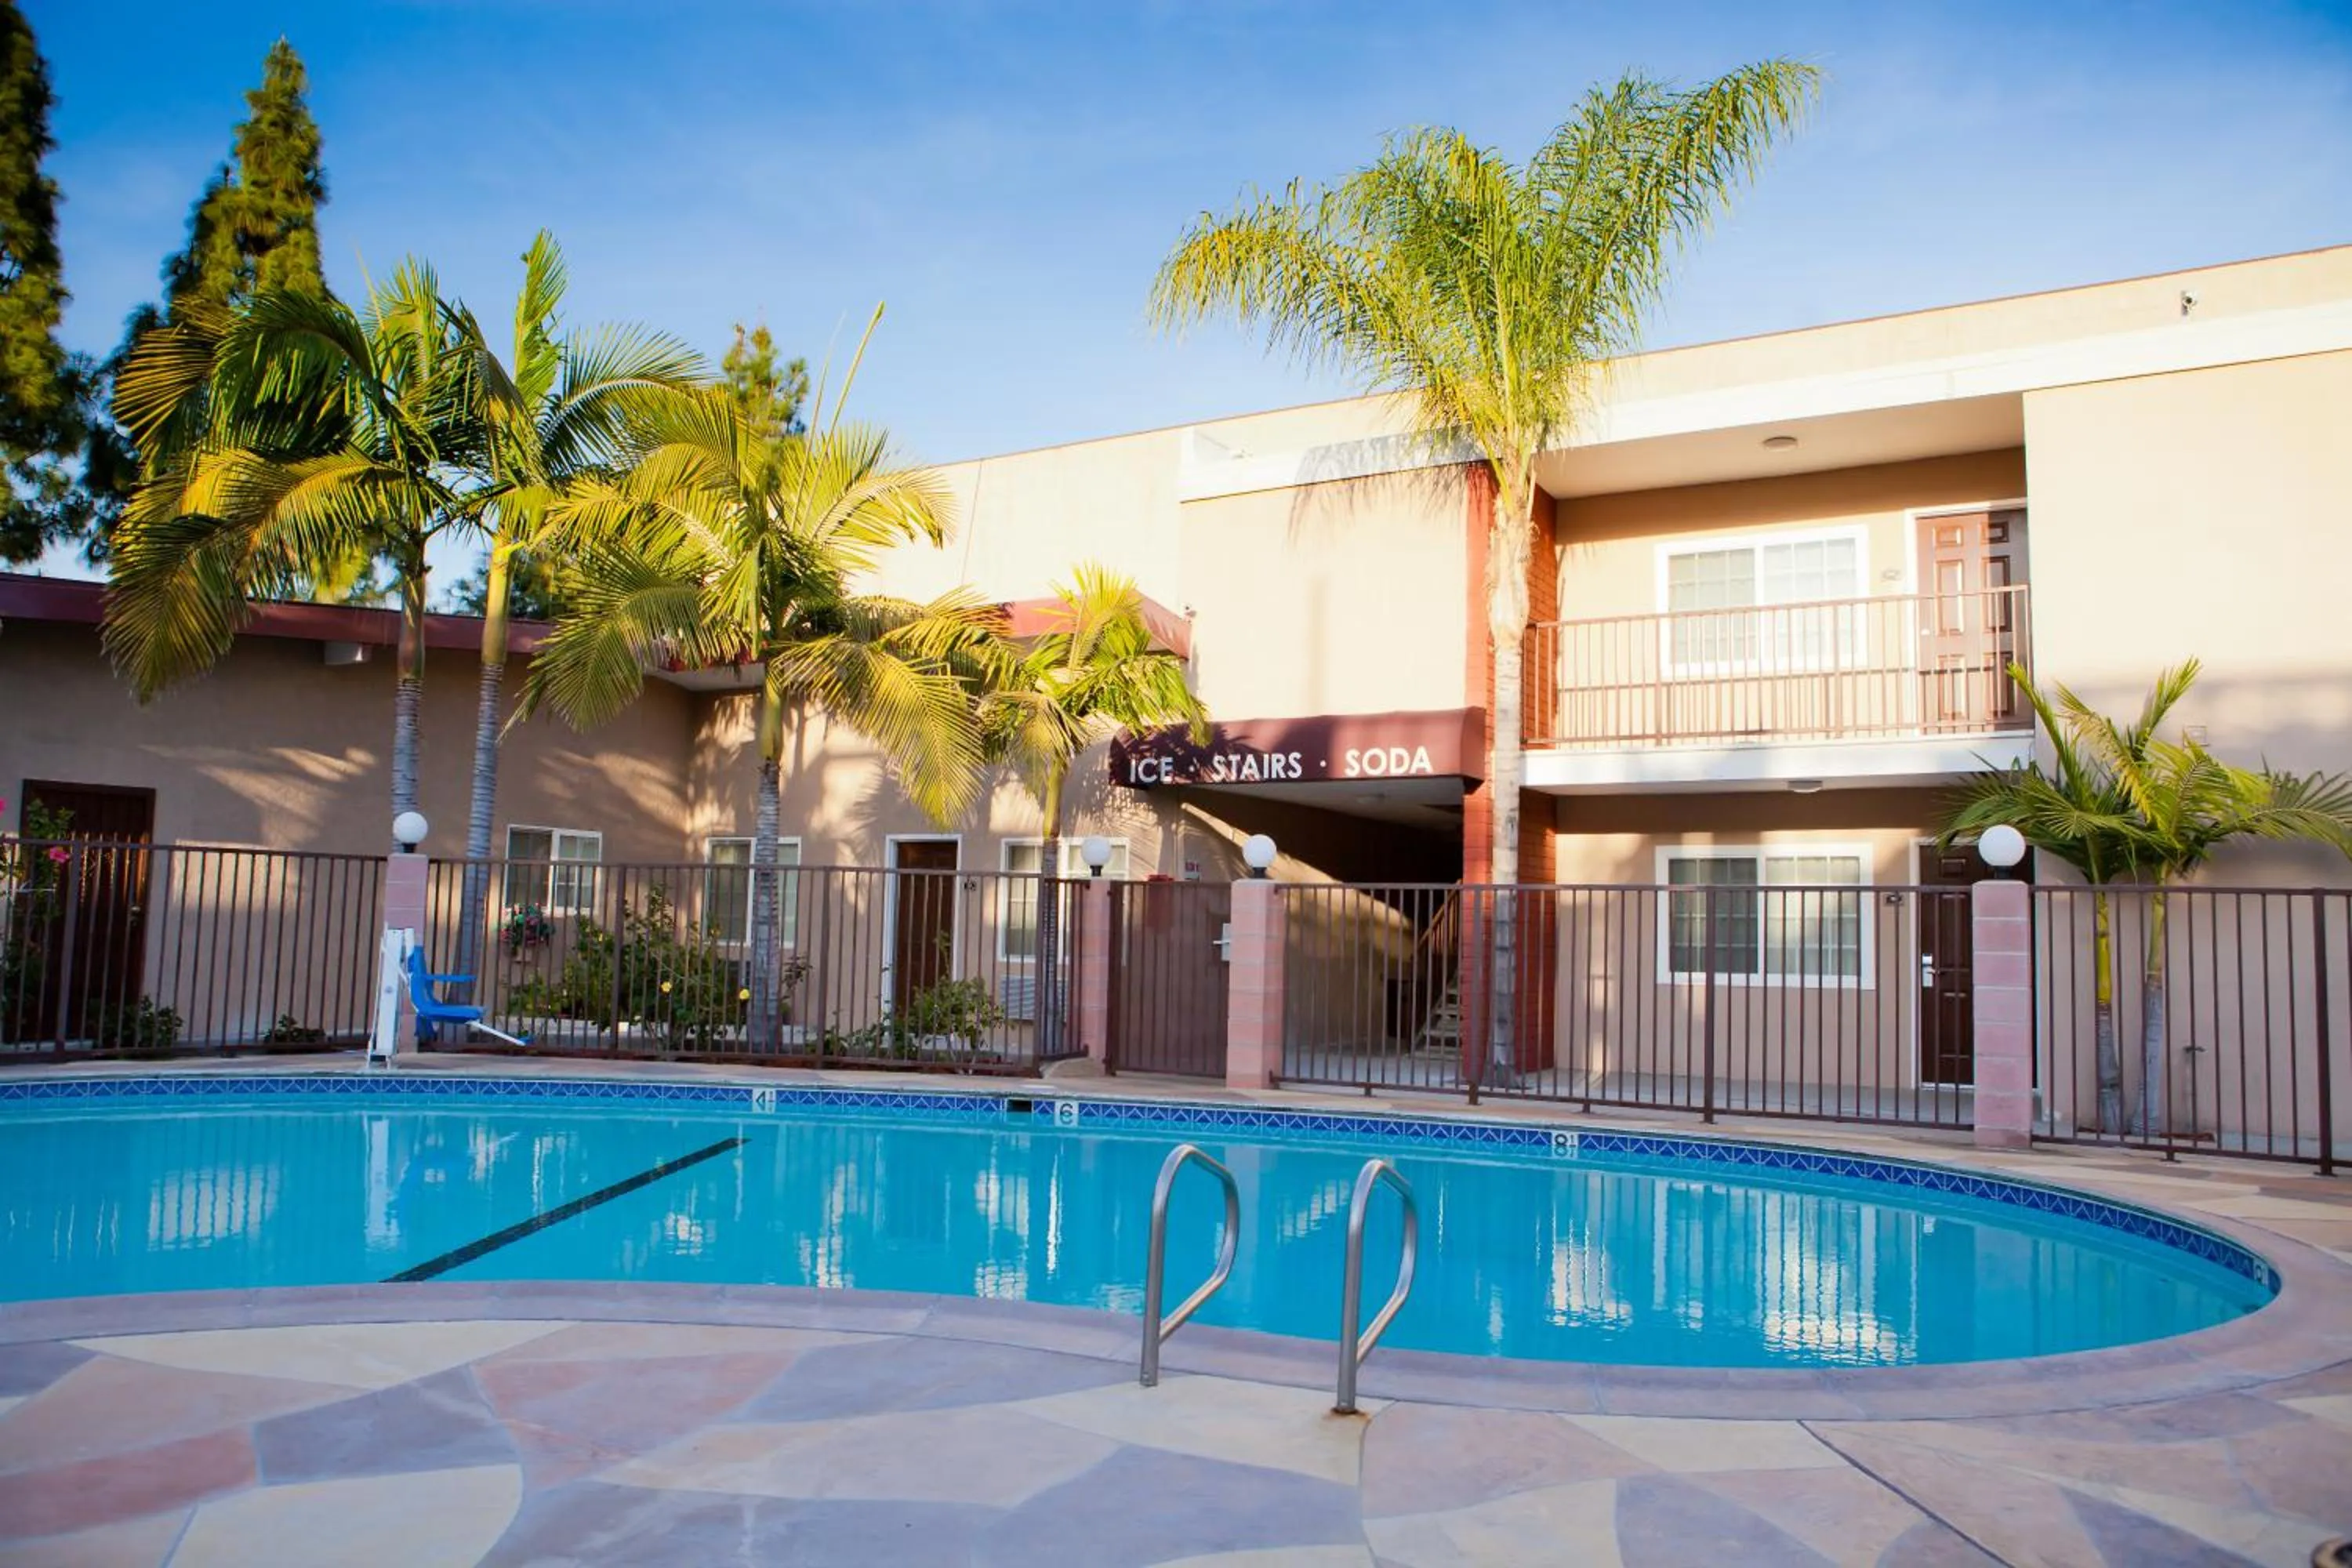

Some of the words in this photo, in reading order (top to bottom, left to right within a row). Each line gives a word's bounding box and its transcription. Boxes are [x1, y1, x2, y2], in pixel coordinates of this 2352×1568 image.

[1130, 757, 1174, 783] ICE
[1212, 752, 1302, 782] STAIRS
[1343, 746, 1434, 778] SODA
